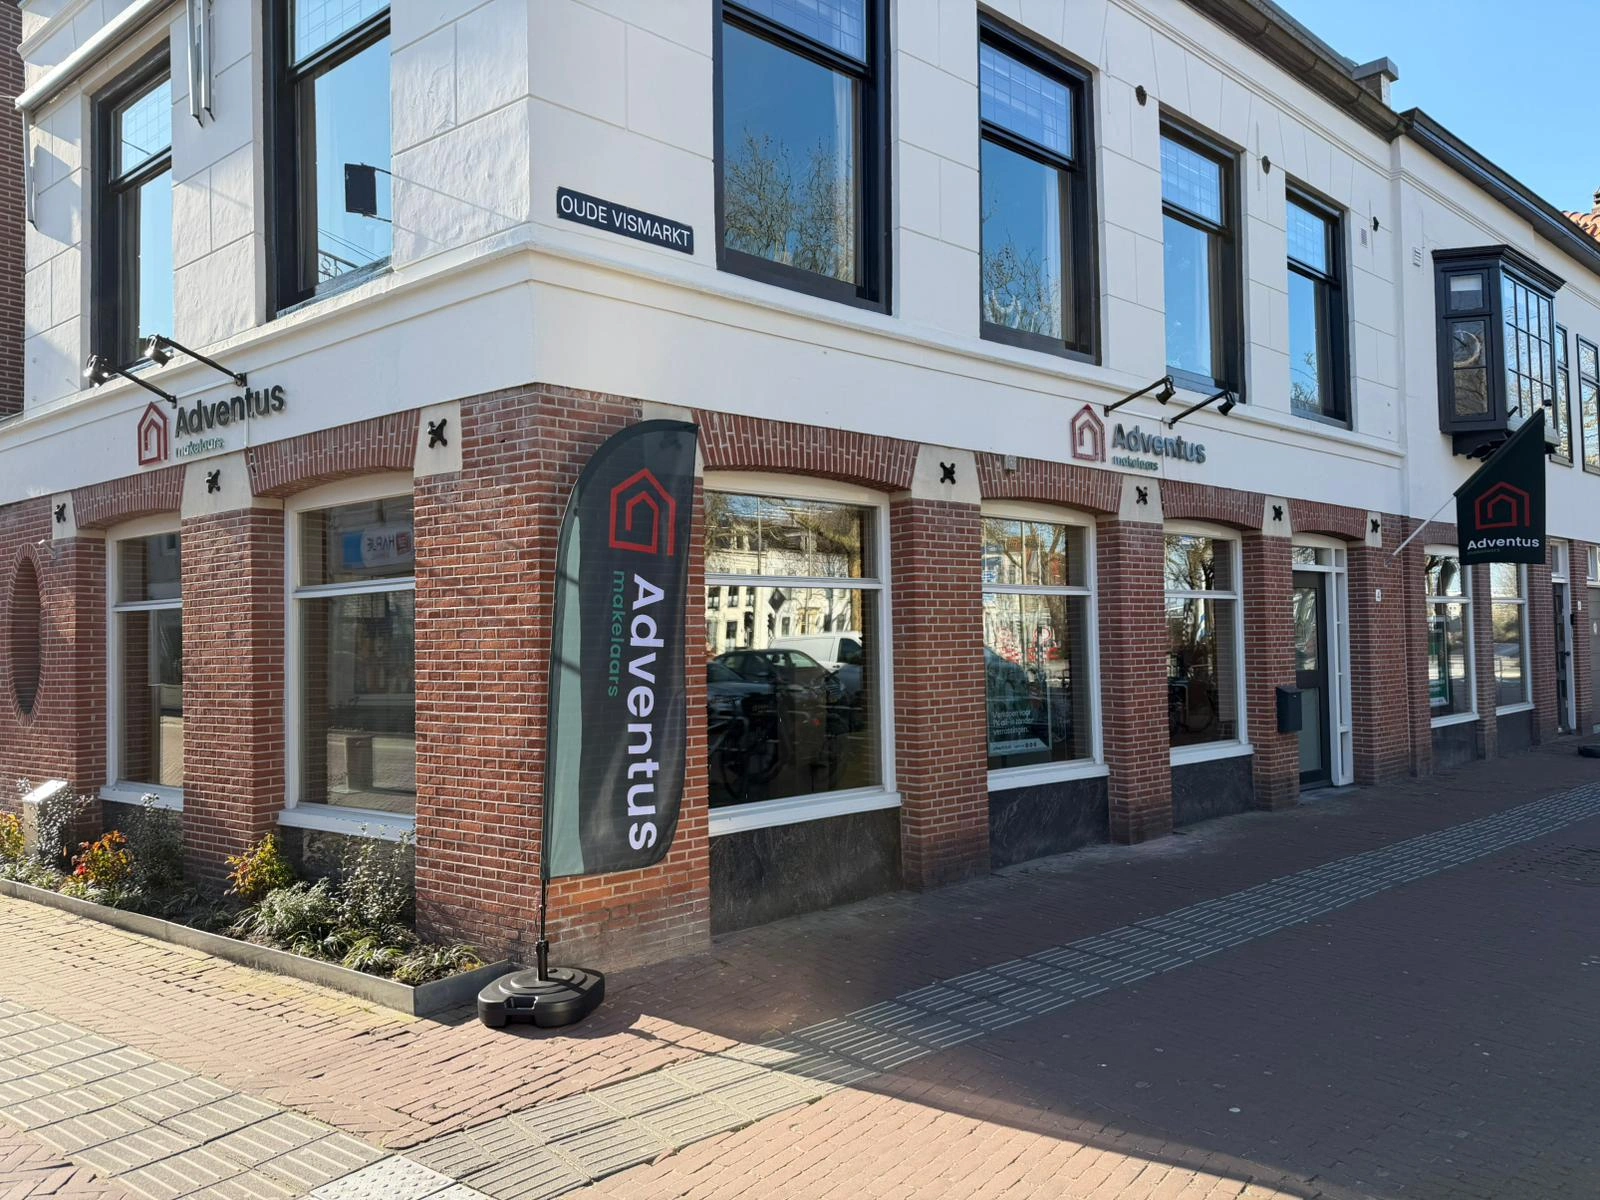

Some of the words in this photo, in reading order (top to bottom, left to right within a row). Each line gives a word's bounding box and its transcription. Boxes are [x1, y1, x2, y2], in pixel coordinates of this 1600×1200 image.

[560, 195, 608, 224] OUDE
[612, 209, 691, 247] VISMARKT
[174, 384, 286, 439] Adventus
[1111, 423, 1207, 464] Adventus
[1466, 535, 1541, 551] Adventus
[608, 570, 625, 698] makelaars
[627, 573, 665, 850] Adventus
